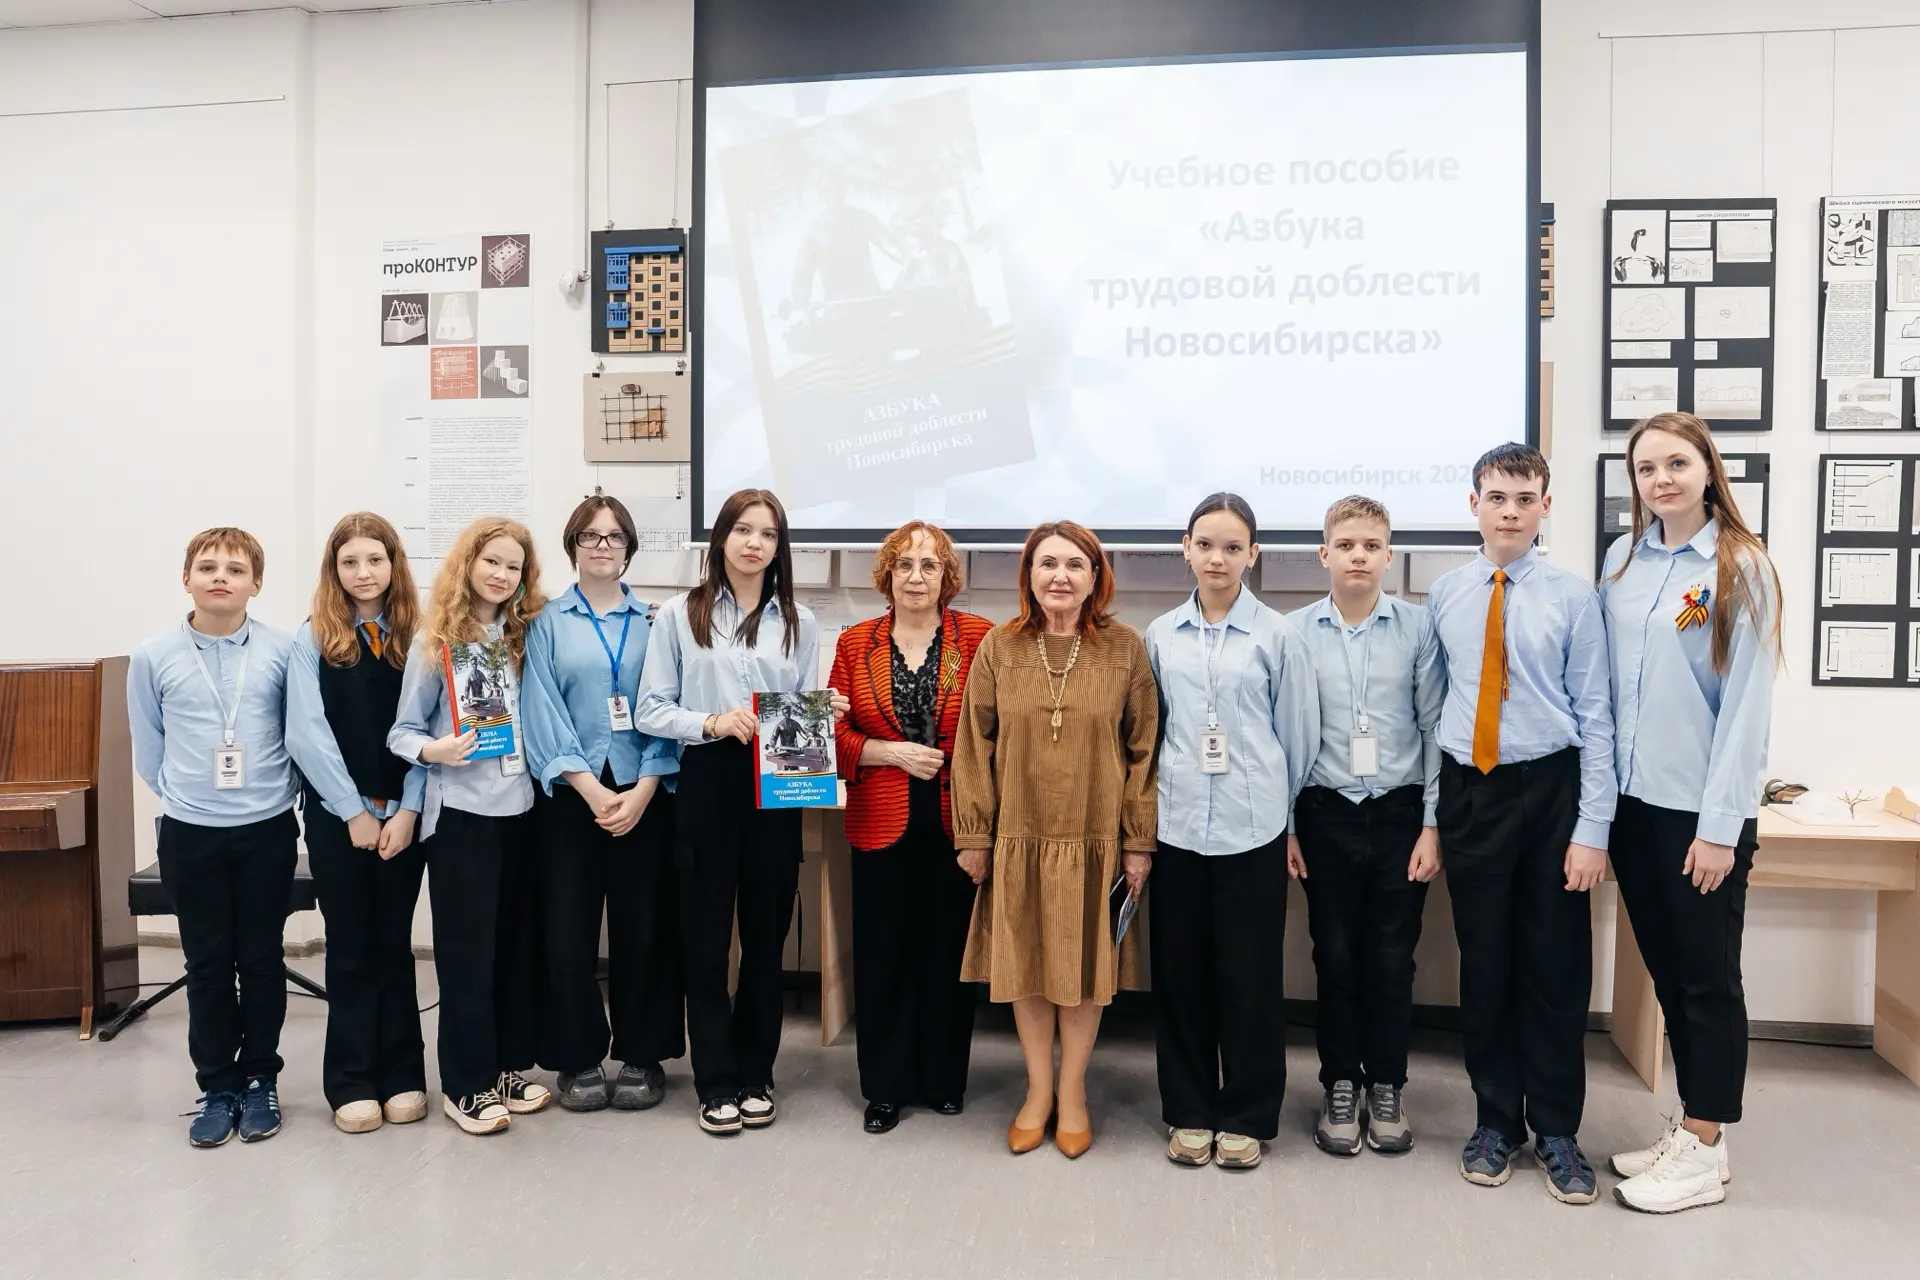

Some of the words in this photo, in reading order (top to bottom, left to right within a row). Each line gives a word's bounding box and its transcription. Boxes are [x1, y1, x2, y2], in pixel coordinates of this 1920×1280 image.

[1105, 155, 1275, 190] Учебное
[1287, 149, 1461, 185] пособие
[1199, 207, 1365, 249] «Азбука
[383, 256, 478, 278] проКОНТУР
[1086, 265, 1276, 309] трудовой
[1288, 263, 1481, 305] доблести
[1125, 322, 1443, 363] Новосибирска»
[863, 392, 942, 424] АЗБУКА
[824, 423, 904, 456] трудовой
[909, 407, 989, 437] доблести
[846, 432, 974, 471] Новосибирска
[1259, 464, 1422, 490] Новосибирск
[1429, 464, 1474, 484] 202
